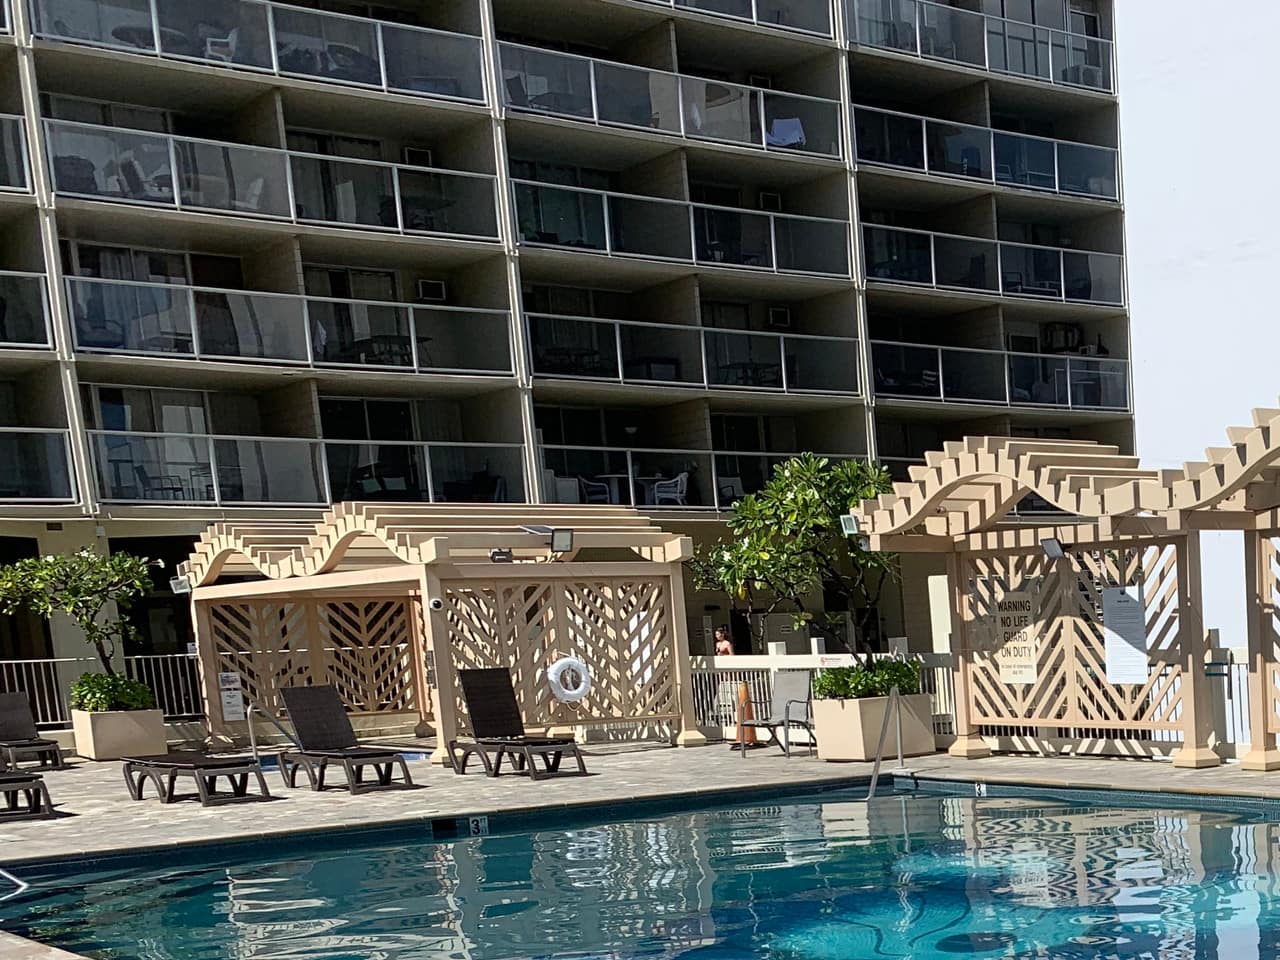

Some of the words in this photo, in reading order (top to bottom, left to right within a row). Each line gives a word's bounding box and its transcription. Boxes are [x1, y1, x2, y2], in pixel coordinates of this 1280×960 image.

[997, 600, 1031, 612] WARNING
[1000, 616, 1011, 627] NO
[1013, 616, 1028, 627] LIFE
[1003, 632, 1028, 642] GUARD
[1001, 647, 1011, 657] ON
[1013, 646, 1032, 657] DUTY
